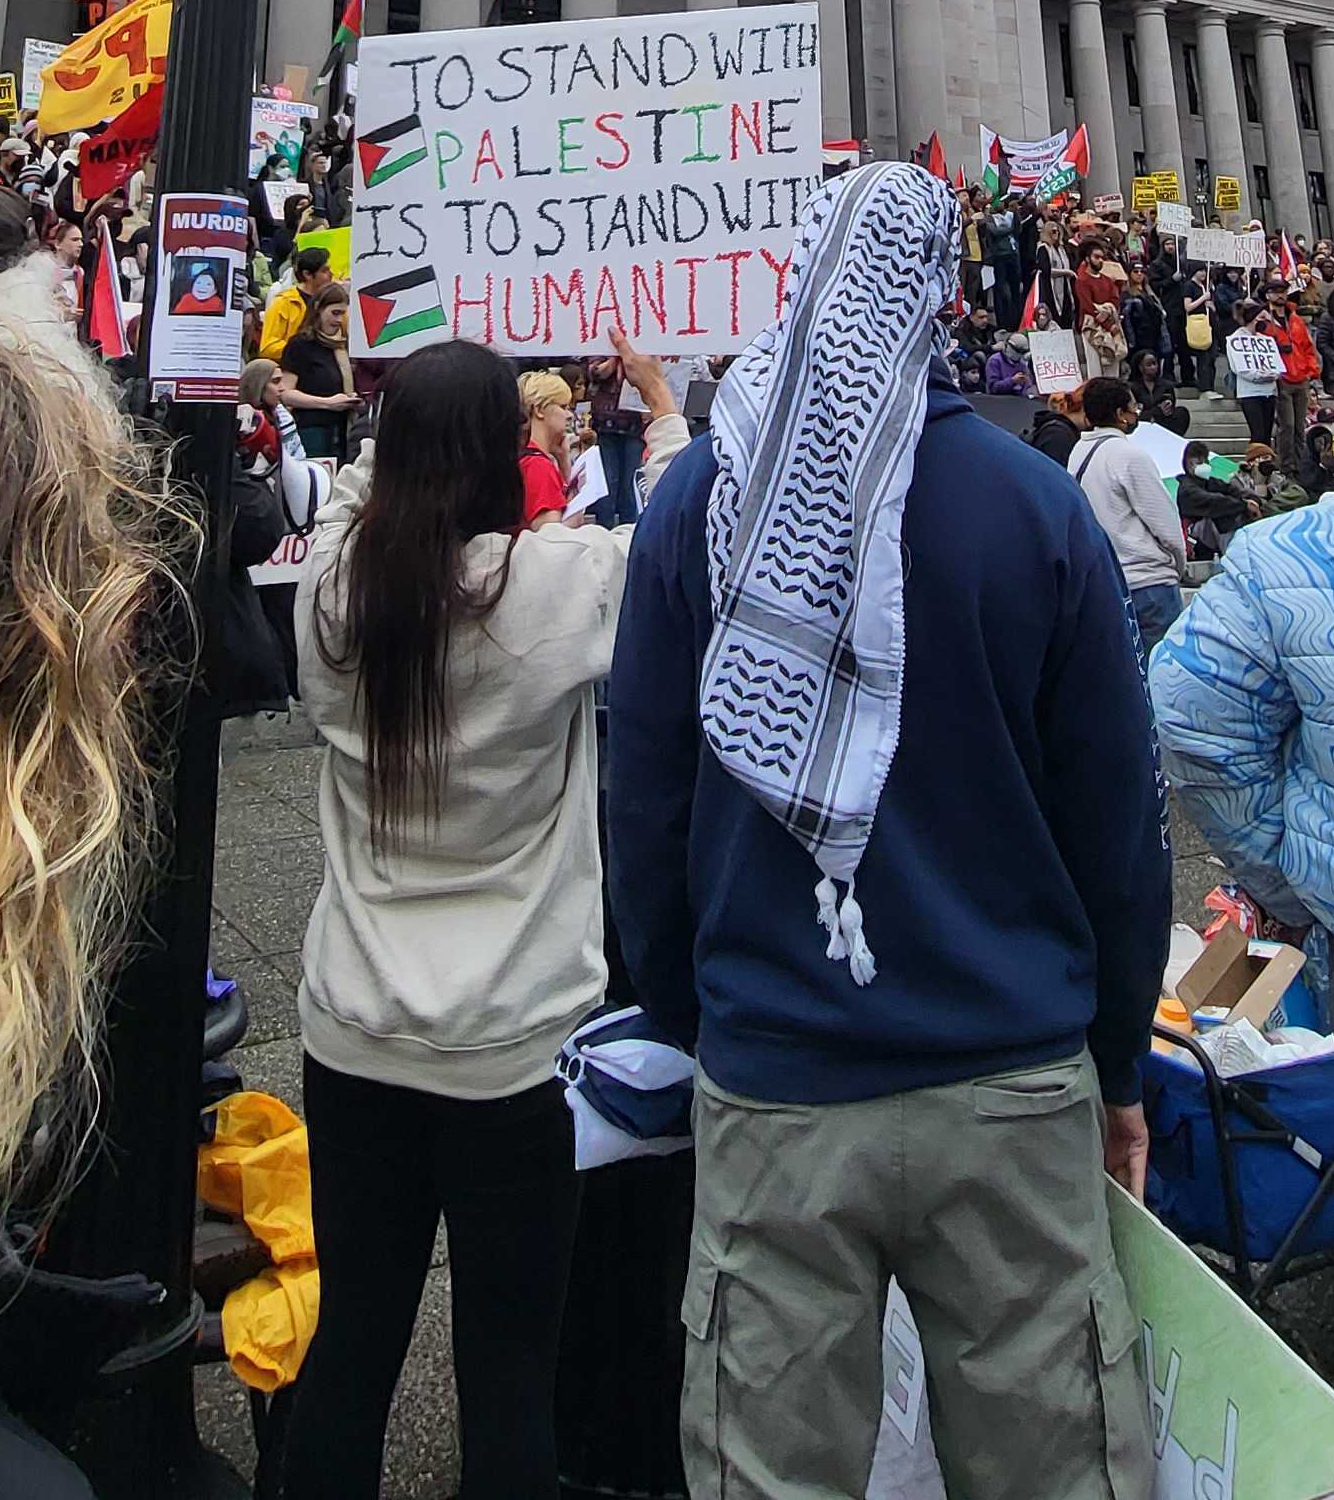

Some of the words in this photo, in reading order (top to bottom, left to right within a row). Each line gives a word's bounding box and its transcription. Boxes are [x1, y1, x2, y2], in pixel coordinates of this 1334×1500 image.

[390, 54, 474, 113] TO
[485, 34, 696, 102] STAND
[710, 23, 818, 80] WITH
[434, 98, 802, 189] PALESTINE
[355, 203, 427, 262] IS
[444, 199, 521, 257] TO
[535, 184, 709, 257] STAND
[713, 175, 821, 234] WIT
[452, 247, 793, 346] HUMANITY
[1230, 336, 1276, 353] CEASE
[1243, 353, 1277, 370] FIRE
